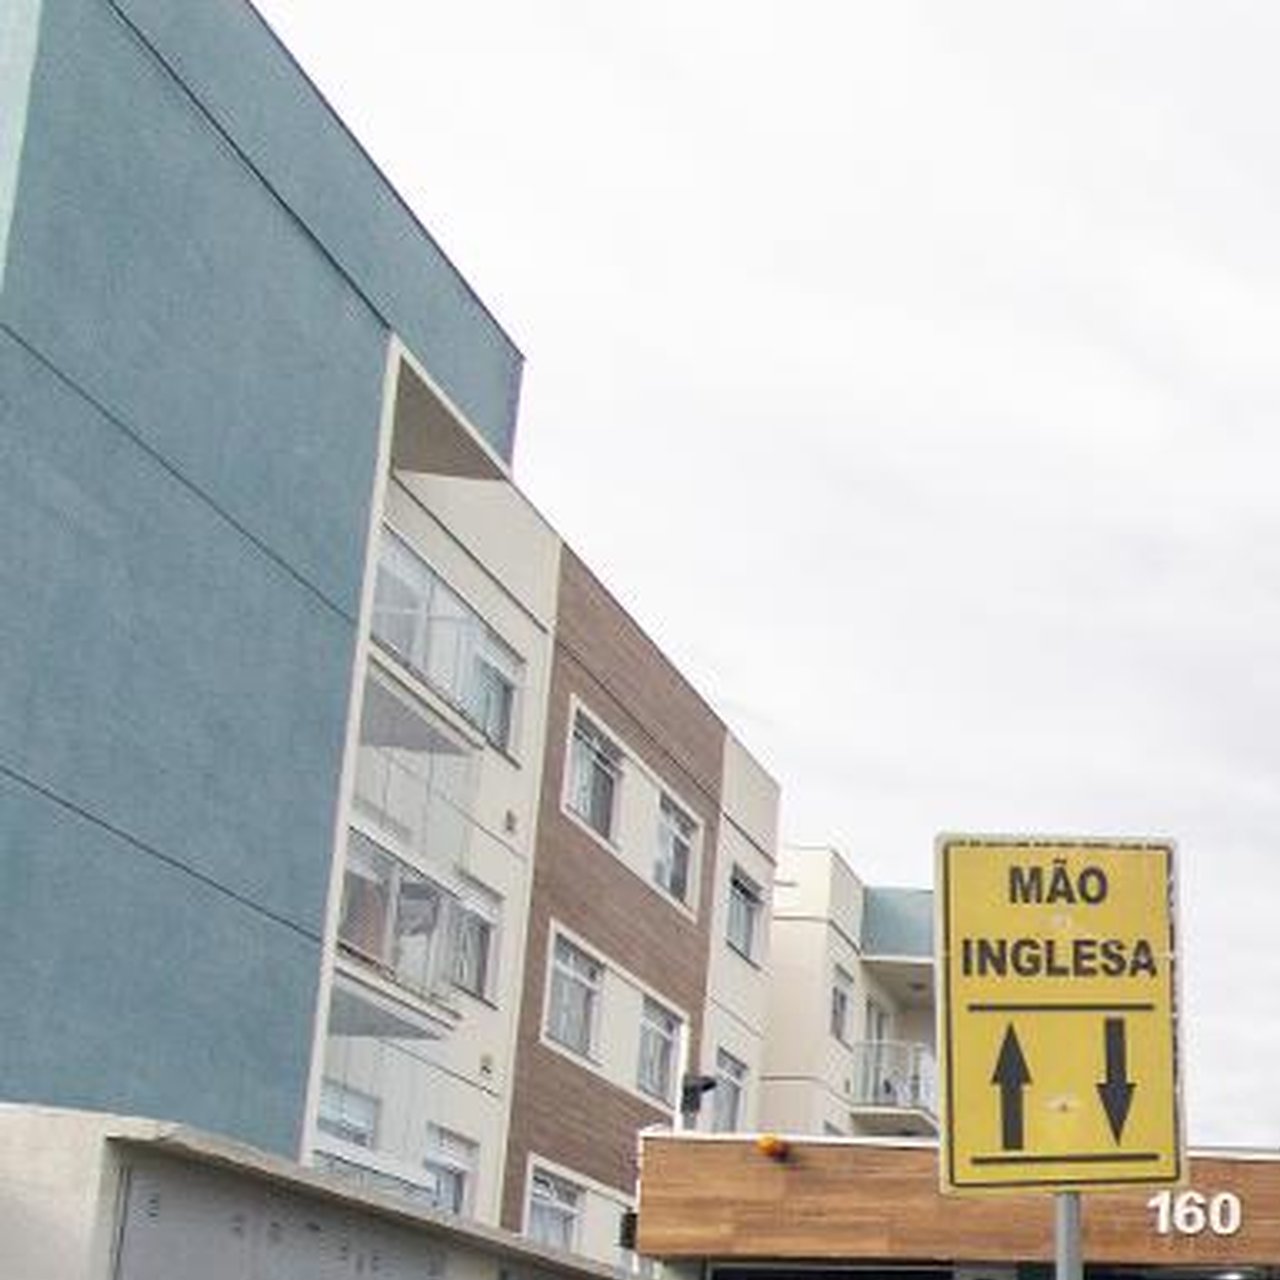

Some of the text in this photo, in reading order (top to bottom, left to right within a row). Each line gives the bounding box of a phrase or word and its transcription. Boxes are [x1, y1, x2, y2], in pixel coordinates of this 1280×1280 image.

[1008, 858, 1109, 905] MÃO
[961, 937, 1158, 978] INGLESA
[1146, 1189, 1242, 1236] 160
